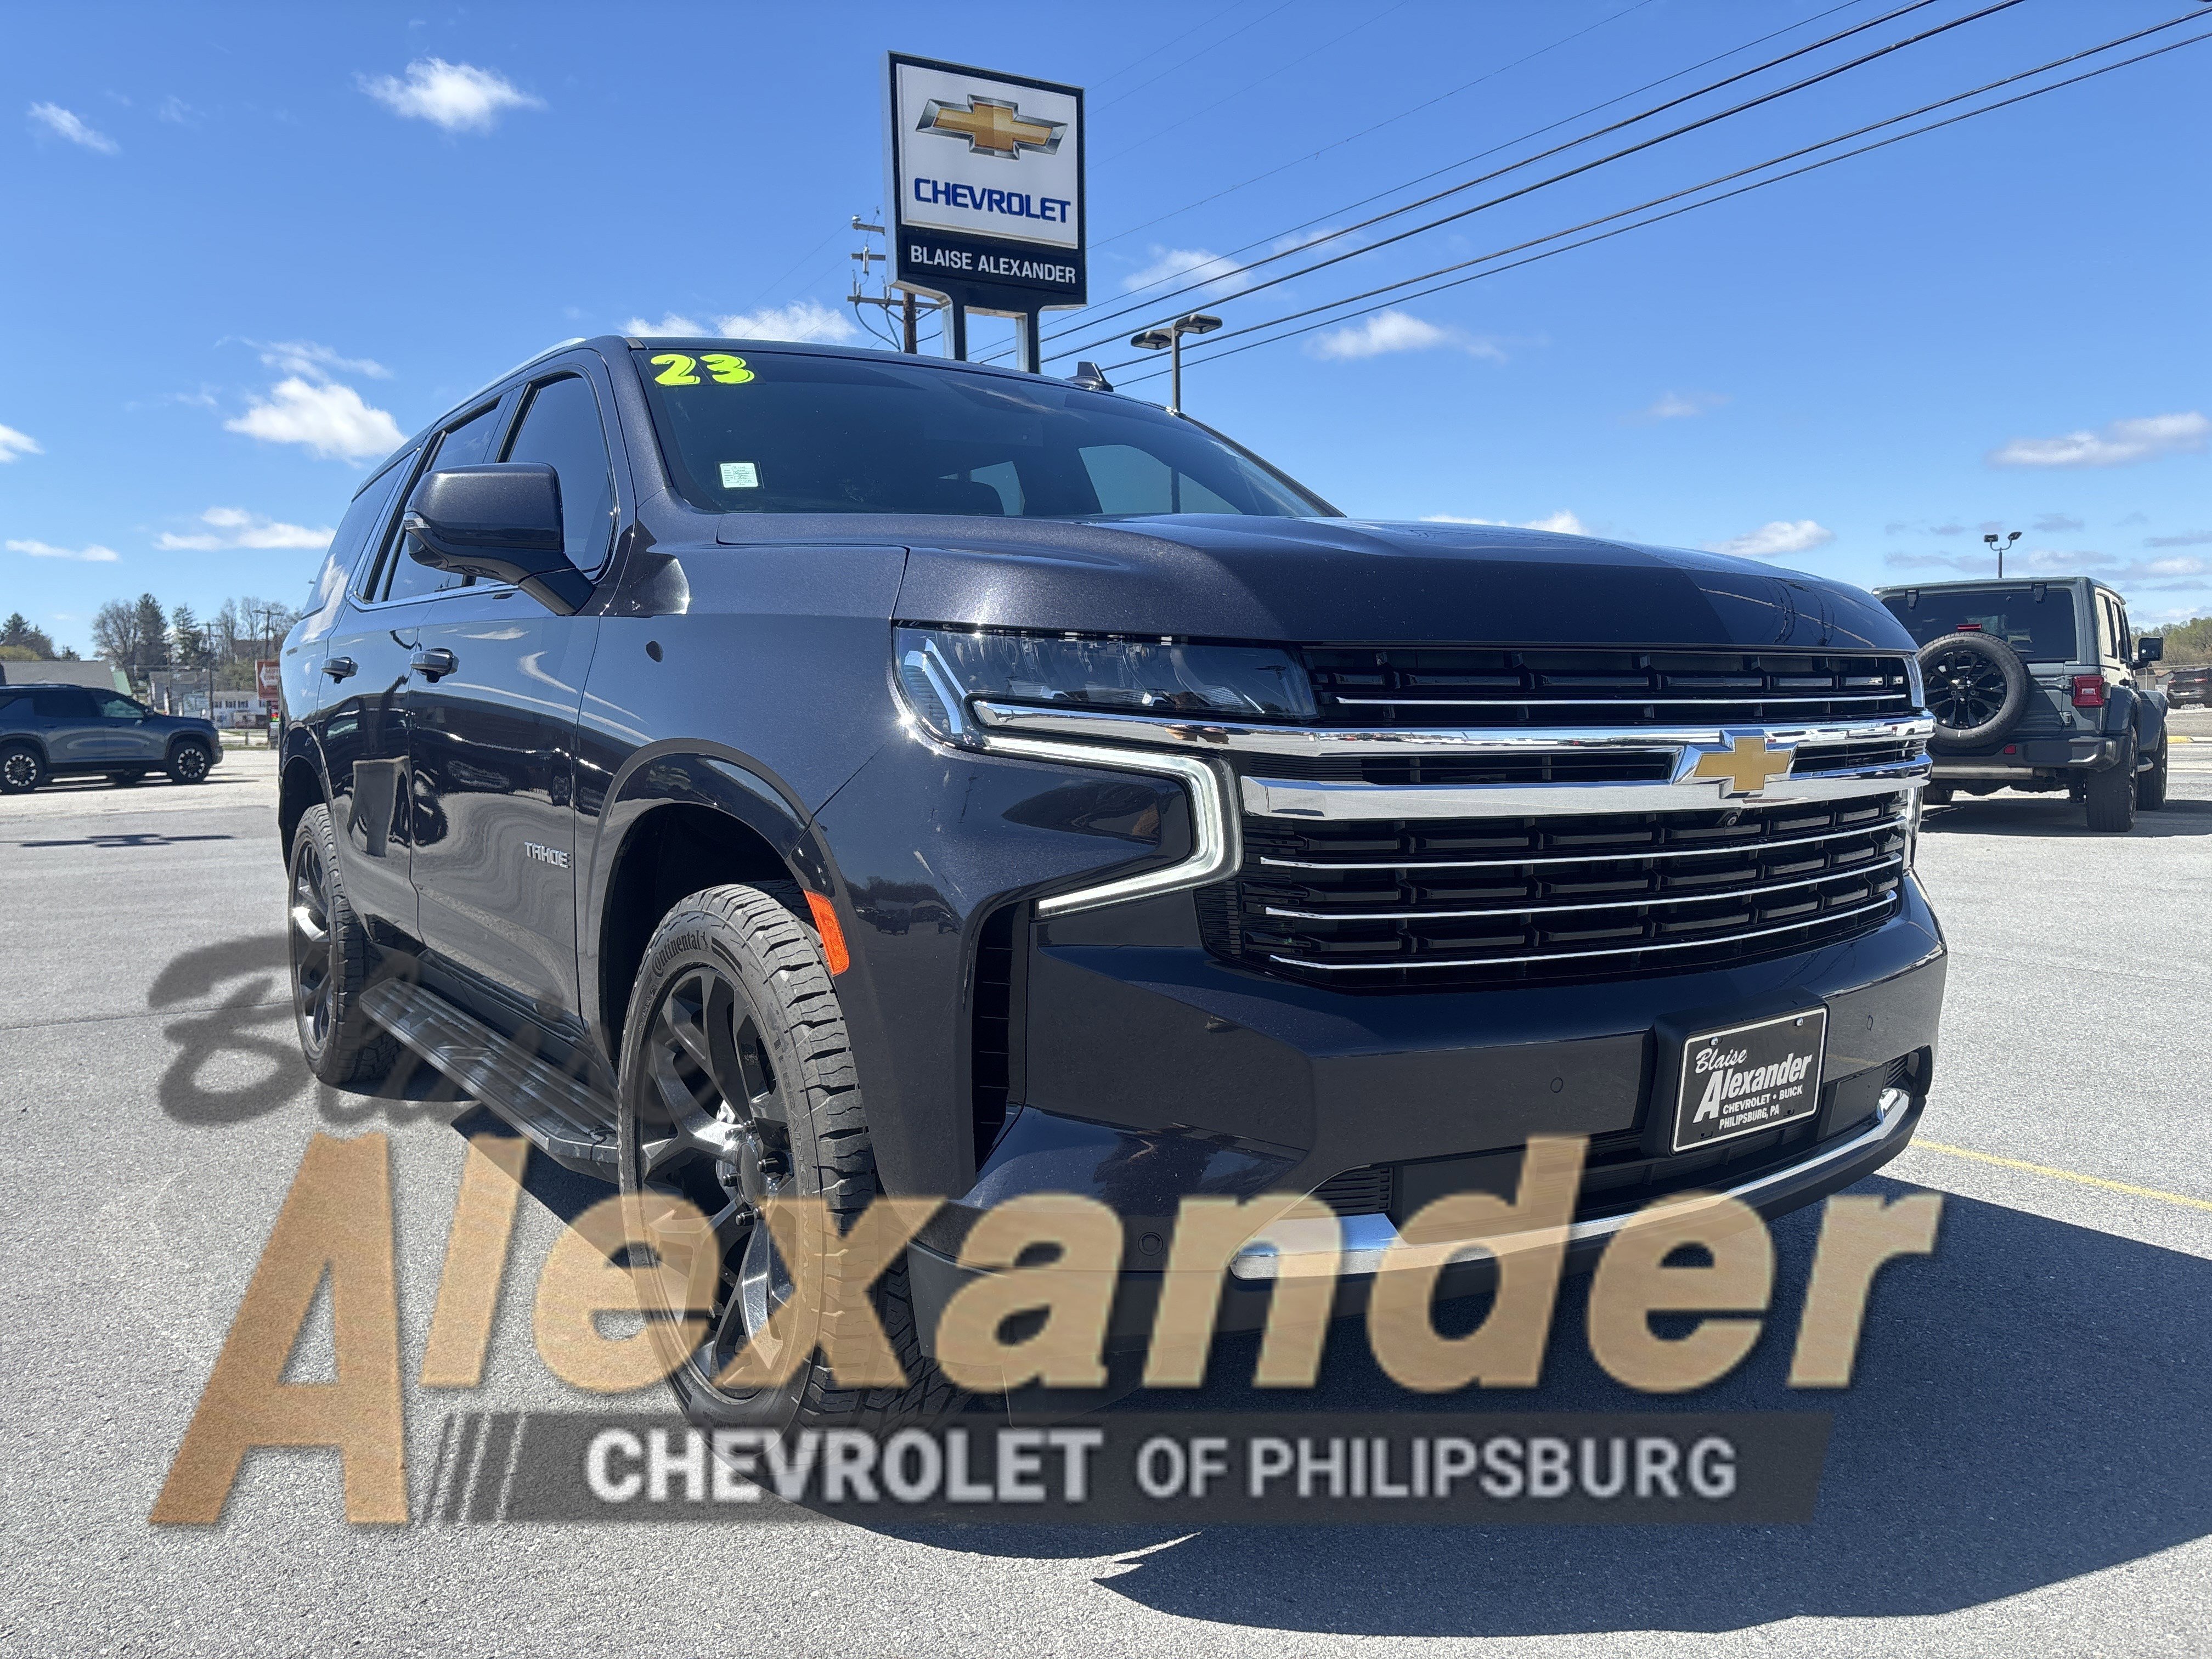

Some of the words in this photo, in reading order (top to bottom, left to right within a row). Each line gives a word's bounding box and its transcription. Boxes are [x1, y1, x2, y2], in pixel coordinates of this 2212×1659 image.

[915, 178, 1071, 223] CHEVROLET
[910, 245, 973, 271] BLAISE
[978, 255, 1076, 285] ALEXANDER
[651, 354, 755, 386] 23
[524, 841, 569, 869] TAHOE
[651, 929, 702, 978] Continental
[1695, 1048, 1747, 1074] Blaise
[1692, 1053, 1813, 1124] Alexander
[1723, 1093, 1771, 1115] CHEVROLET
[1779, 1084, 1803, 1101] BUICK
[1719, 1107, 1768, 1130] PHILIPSBURG,
[1770, 1104, 1780, 1116] PA
